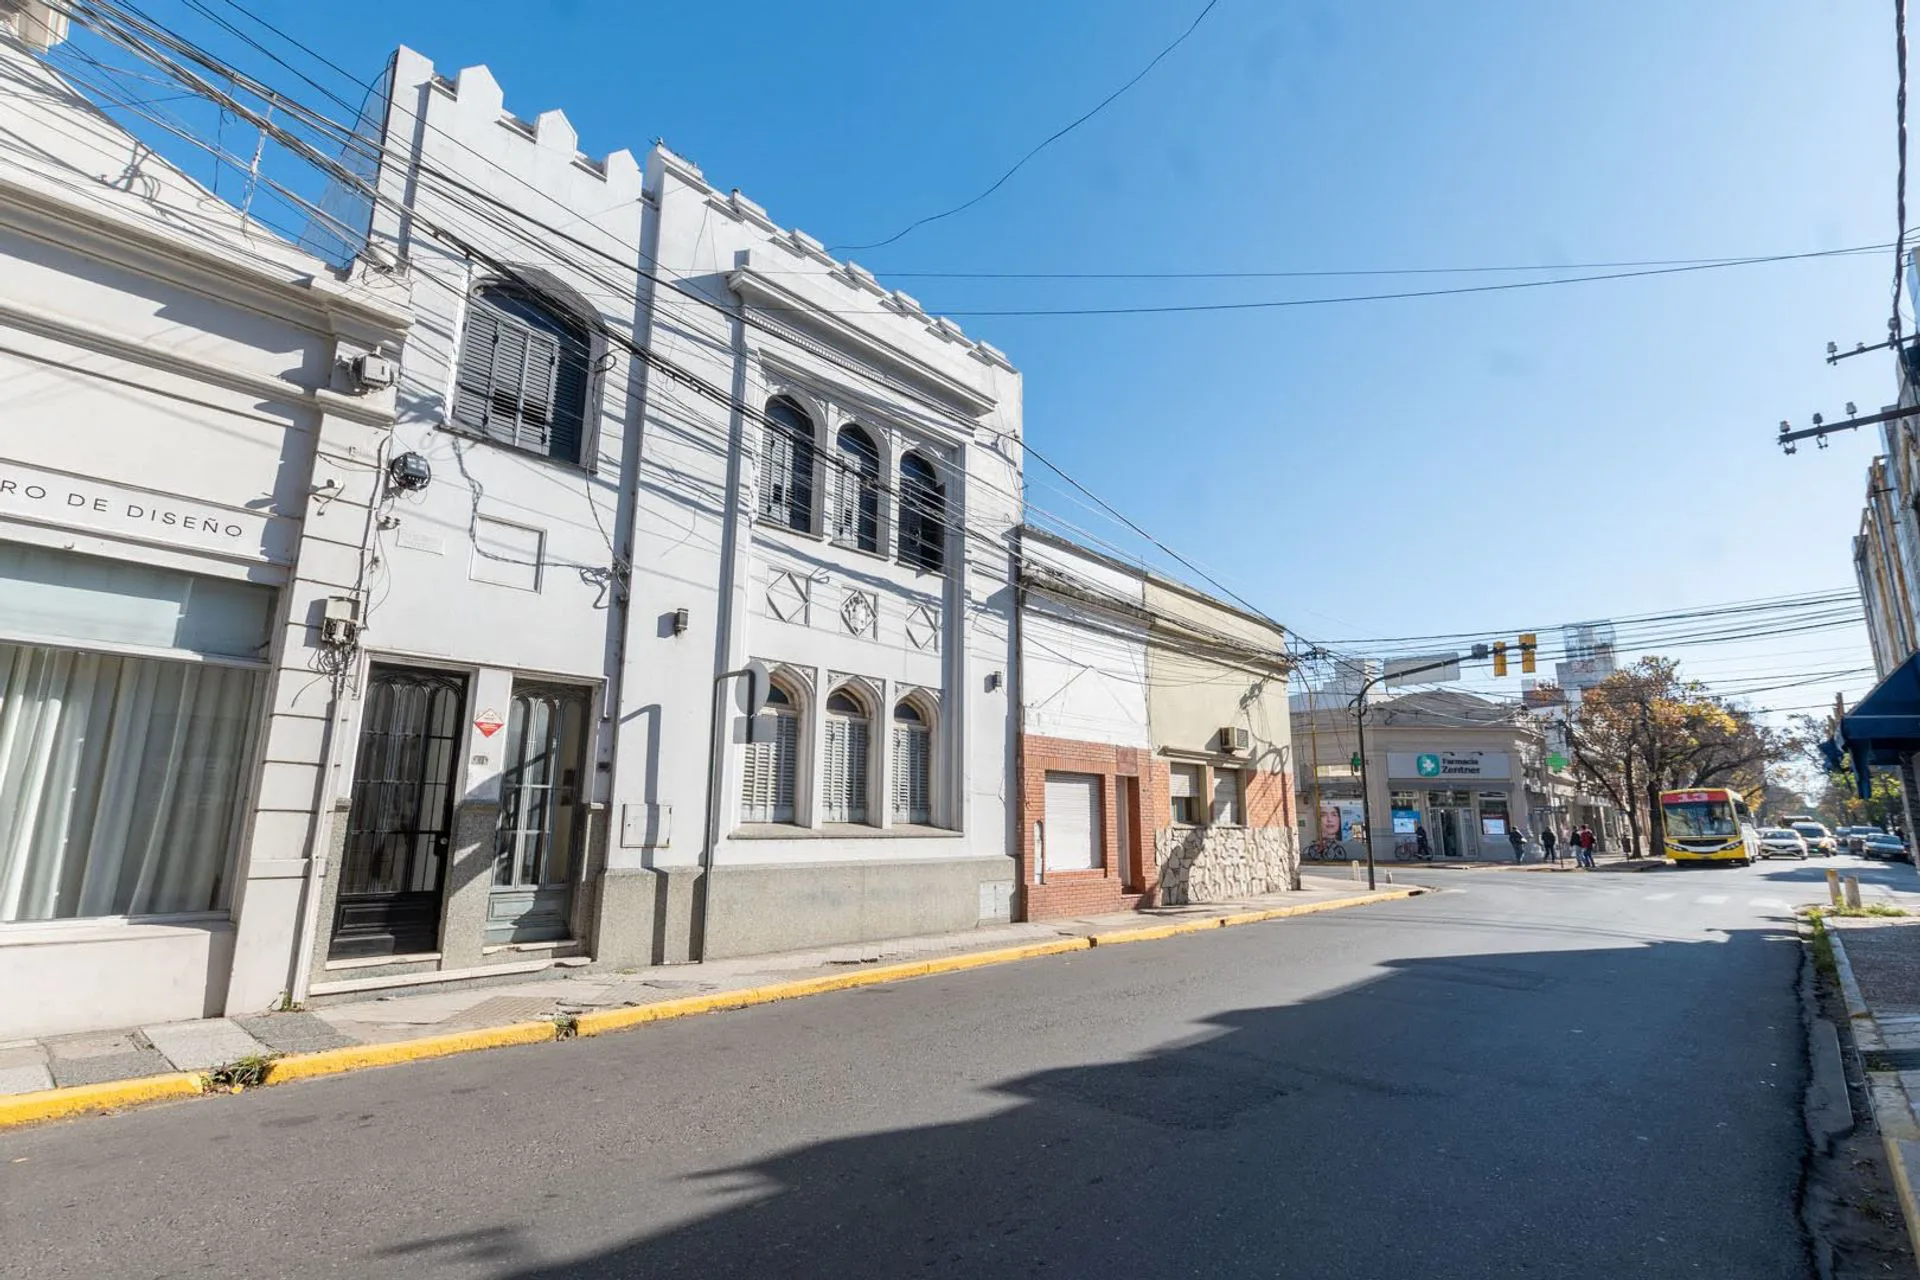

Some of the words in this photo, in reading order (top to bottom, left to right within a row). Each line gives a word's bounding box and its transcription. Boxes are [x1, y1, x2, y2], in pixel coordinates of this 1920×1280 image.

[67, 493, 108, 512] DE
[127, 505, 242, 537] DISEÑO
[1441, 766, 1481, 774] Zentner
